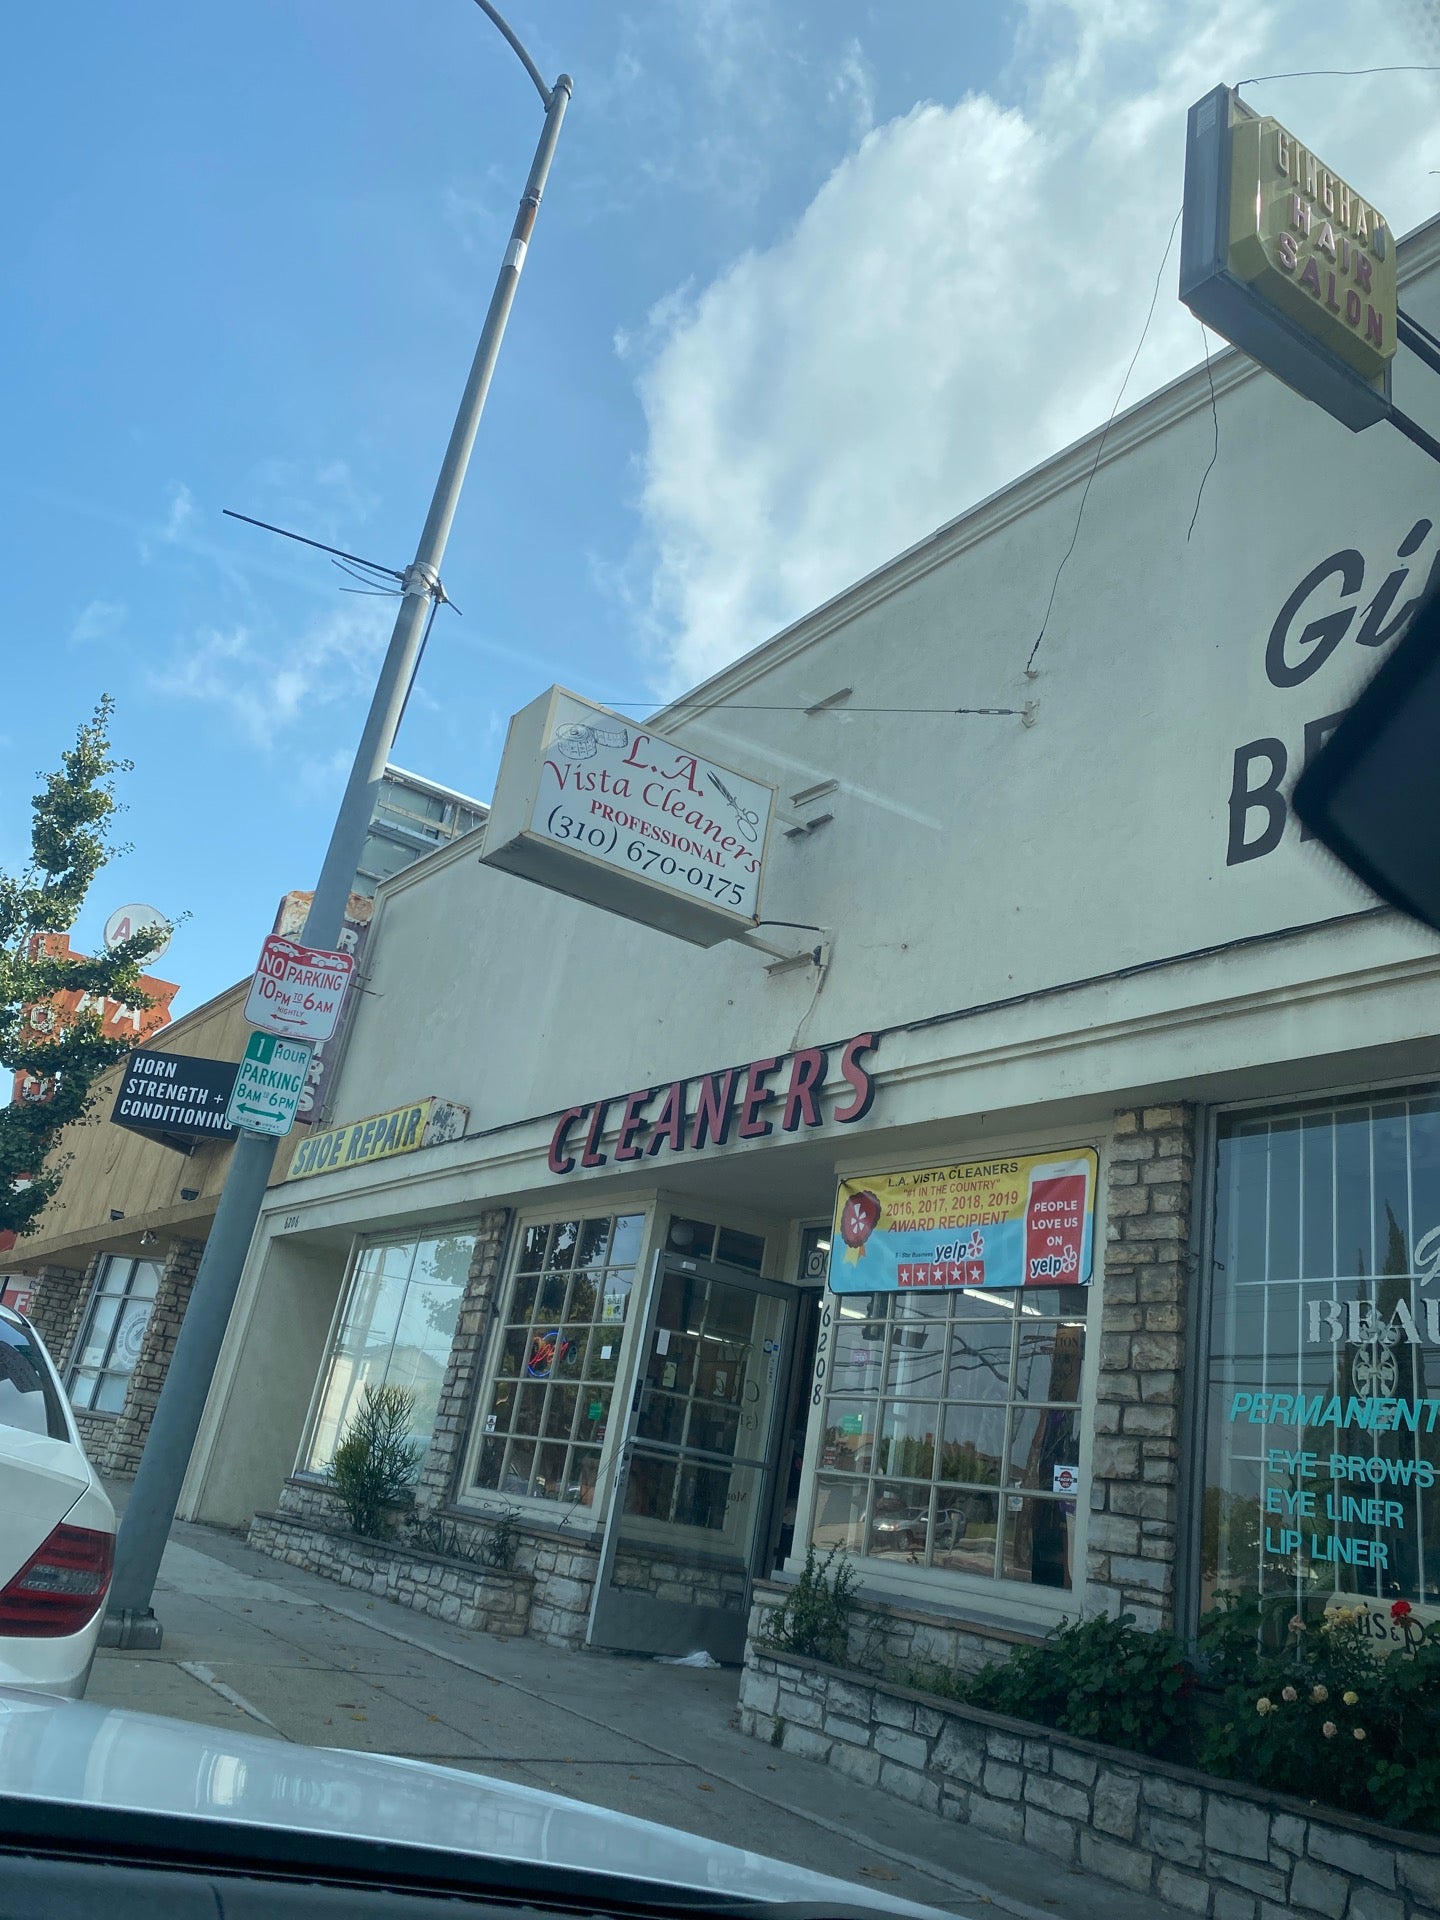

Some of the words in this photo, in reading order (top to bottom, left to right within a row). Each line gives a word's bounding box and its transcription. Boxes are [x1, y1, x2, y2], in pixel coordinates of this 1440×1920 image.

[1290, 192, 1374, 295] HAIR
[1279, 231, 1384, 349] SALON
[622, 735, 705, 797] L.A.
[543, 760, 632, 798] Vista
[642, 782, 762, 874] Cleaners
[590, 799, 726, 868] PROFESSIONAL
[547, 805, 619, 855] (310)
[627, 840, 746, 906] 670-0175
[260, 951, 285, 977] NO
[286, 966, 343, 991] PARKING
[277, 1006, 305, 1018] NIGHTLY
[256, 1038, 265, 1058] 1
[274, 1048, 307, 1065] HOUR
[132, 1057, 178, 1078] HORN
[241, 1062, 302, 1093] PARKING
[126, 1078, 209, 1105] STRENGTH
[236, 1083, 262, 1103] 8AM
[268, 1092, 295, 1110] 6PM
[547, 1032, 880, 1175] CLEANERS
[292, 1130, 347, 1176] SHOE
[345, 1107, 422, 1163] REPAIR
[888, 1177, 909, 1187] L.A.
[912, 1171, 946, 1185] VISTA
[948, 1162, 1019, 1180] CLEANERS
[886, 1201, 915, 1217] 2016,
[918, 1198, 948, 1214] 2017,
[952, 1195, 984, 1210] 2018,
[987, 1190, 1019, 1208] 2019
[918, 1186, 928, 1197] IN
[931, 1184, 948, 1196] THE
[888, 1217, 936, 1233] AWARD
[938, 1210, 1010, 1231] RECIPIENT
[1034, 1200, 1078, 1213] PEOPLE
[1032, 1218, 1061, 1230] LOVE
[1064, 1217, 1078, 1228] US
[934, 1240, 967, 1264] yelp
[1046, 1236, 1063, 1246] ON
[1030, 1254, 1062, 1278] yelp
[813, 1304, 831, 1406] 6208
[1229, 1392, 1440, 1433] PERMANENT
[1268, 1449, 1318, 1478] EYE
[1329, 1453, 1436, 1488] BROWS
[1266, 1487, 1316, 1518] EYE
[1326, 1494, 1404, 1529] LINER
[1265, 1527, 1303, 1555] LIP
[1311, 1533, 1389, 1570] LINER
